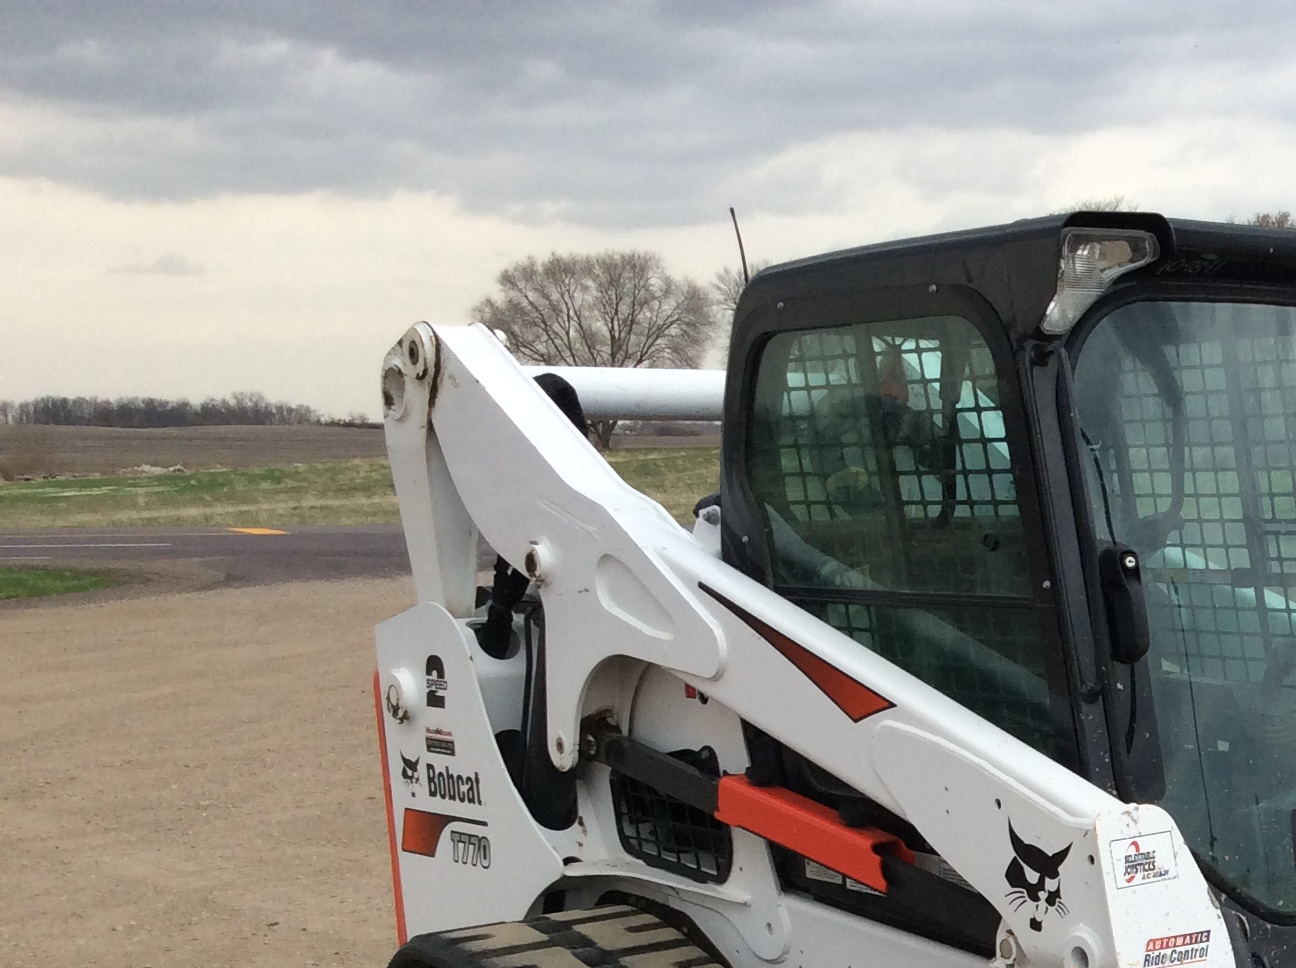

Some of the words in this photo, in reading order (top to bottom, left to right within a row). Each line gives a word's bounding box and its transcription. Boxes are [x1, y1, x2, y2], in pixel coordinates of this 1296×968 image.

[425, 654, 446, 710] 2
[426, 677, 448, 691] SPEED
[425, 762, 483, 807] Bobcat
[450, 829, 492, 870] T770
[1143, 951, 1168, 968] Ride
[1169, 944, 1209, 964] Control
[1146, 931, 1209, 951] AUTOMATIC
